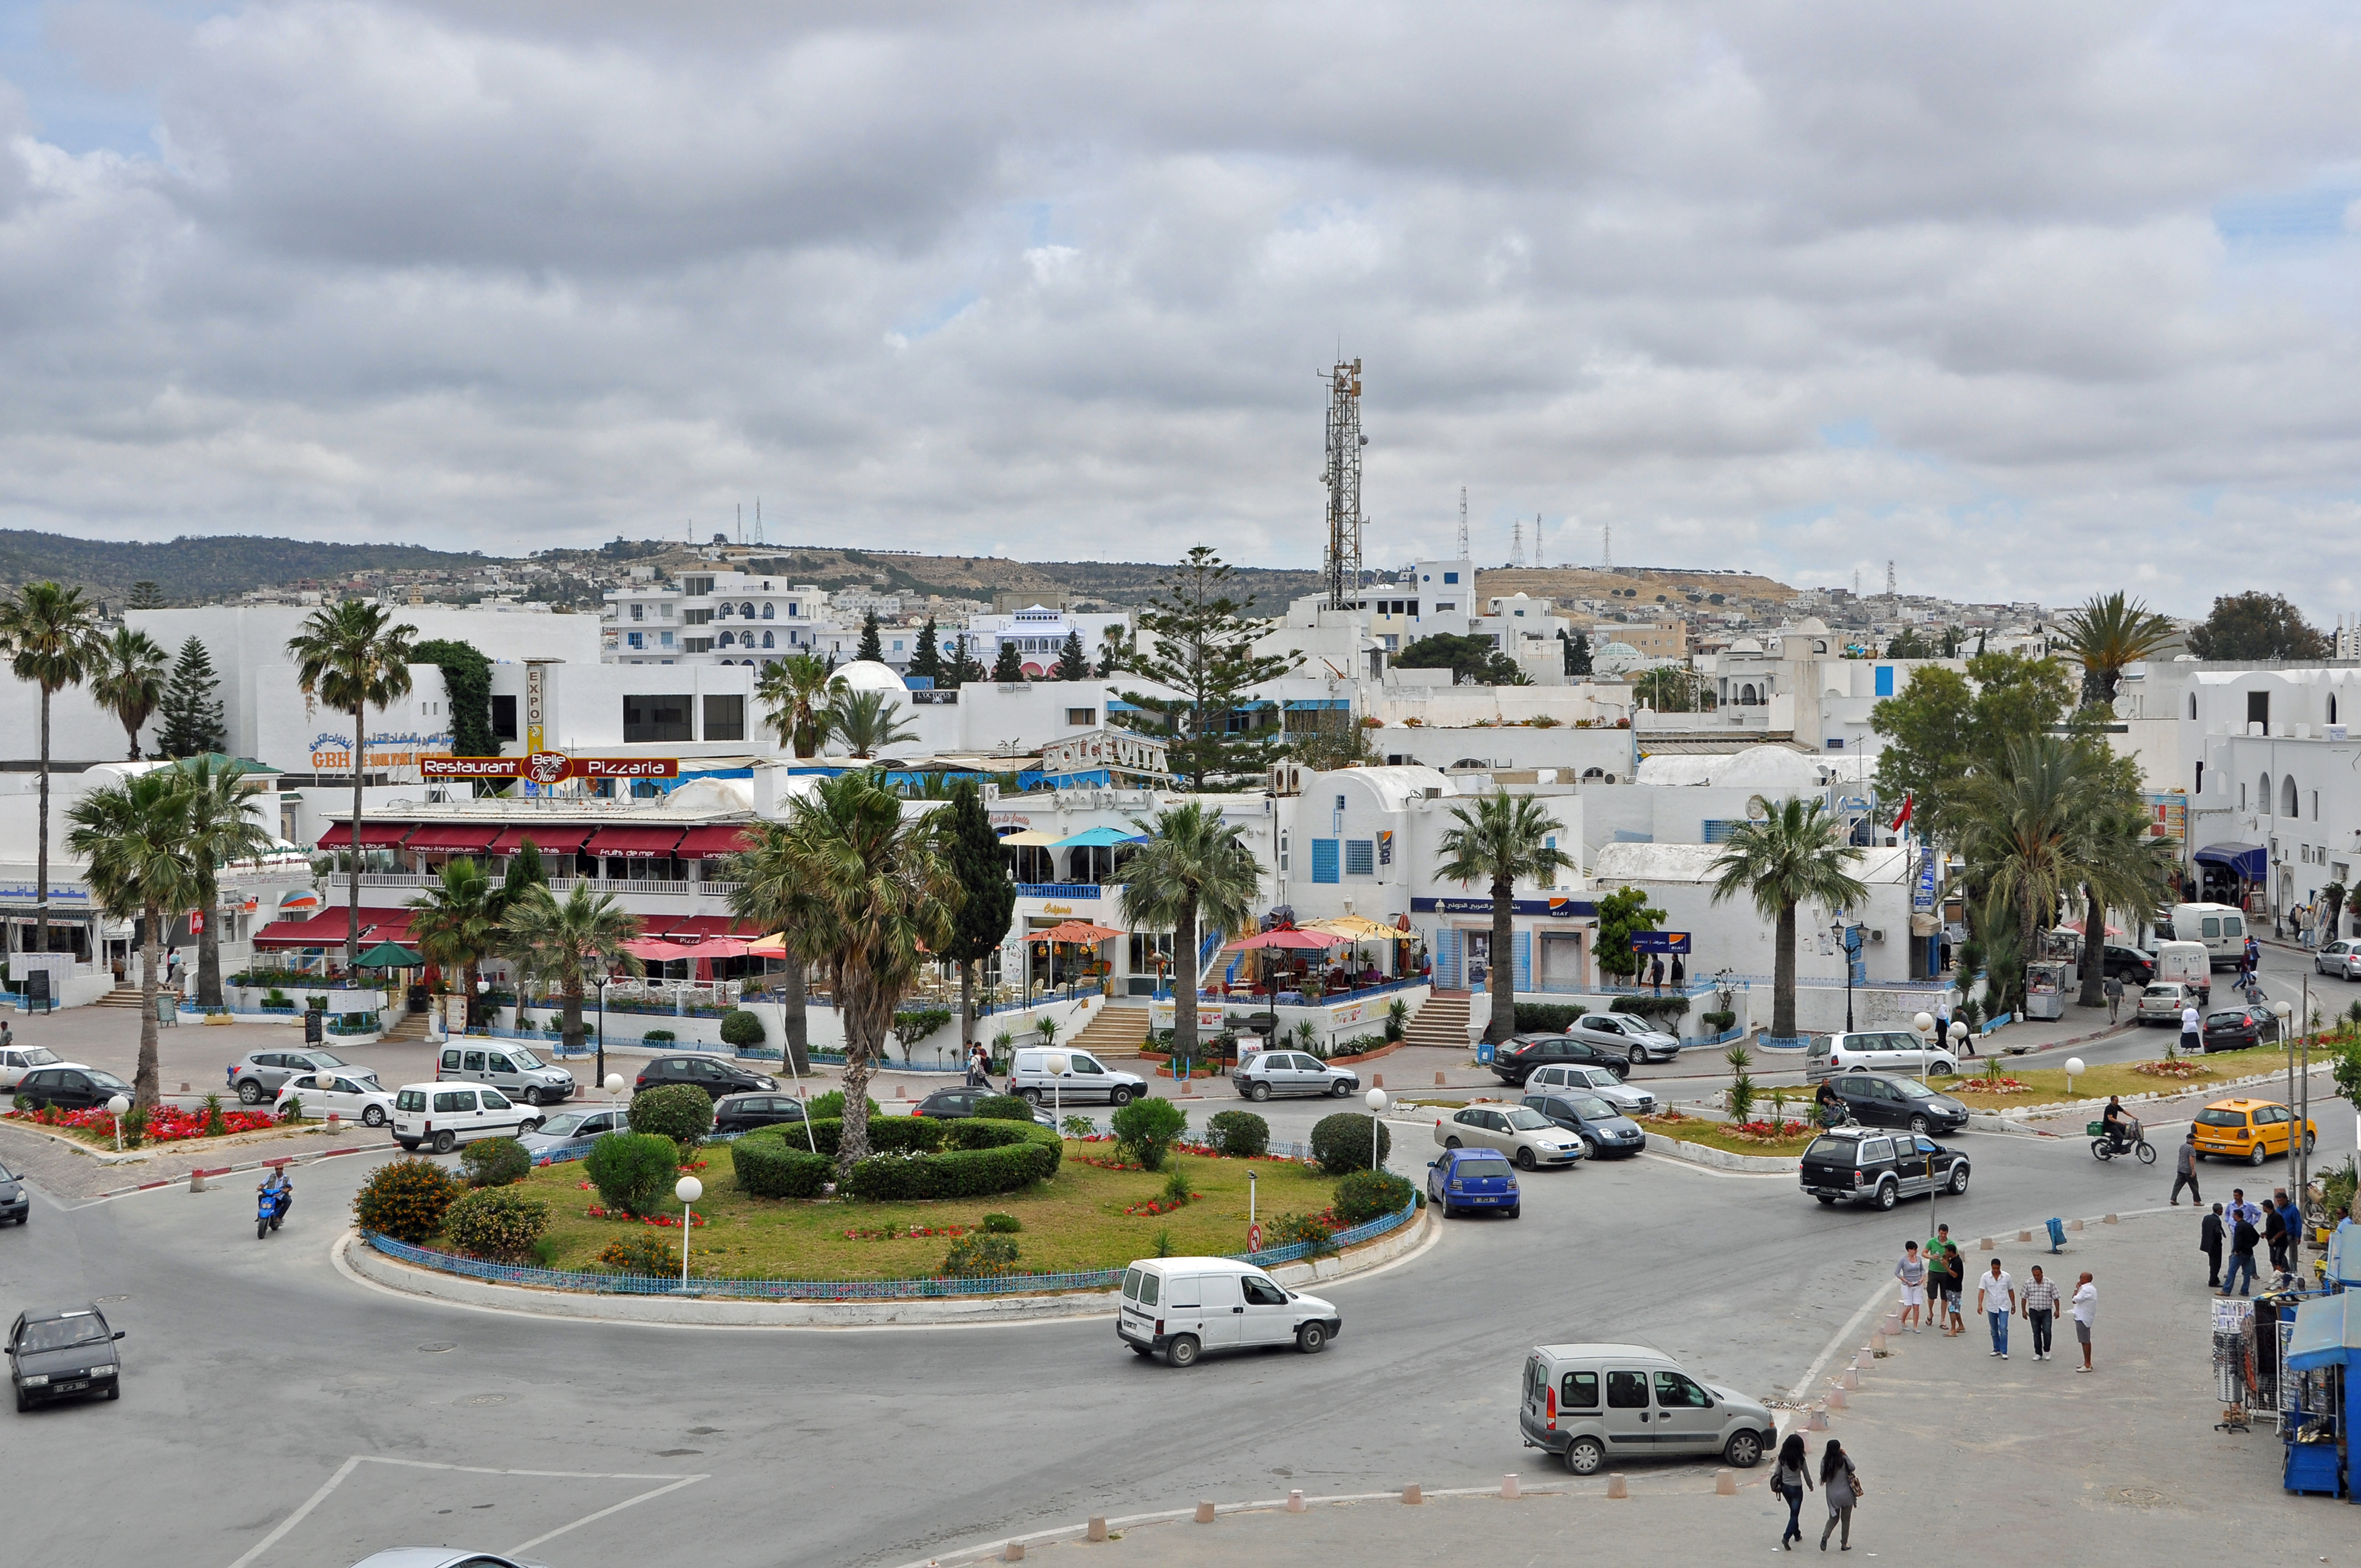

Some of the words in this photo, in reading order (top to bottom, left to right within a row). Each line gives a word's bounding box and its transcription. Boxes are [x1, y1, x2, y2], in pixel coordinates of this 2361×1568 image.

[529, 672, 540, 719] EXPO
[312, 751, 350, 768] GBH
[532, 754, 566, 765] Belle
[1043, 734, 1114, 771] DOLCE
[1117, 738, 1169, 772] VITA
[424, 760, 516, 773] Restaurant
[531, 764, 559, 782] Vue
[588, 760, 665, 774] Pizzaria
[193, 915, 204, 930] illy
